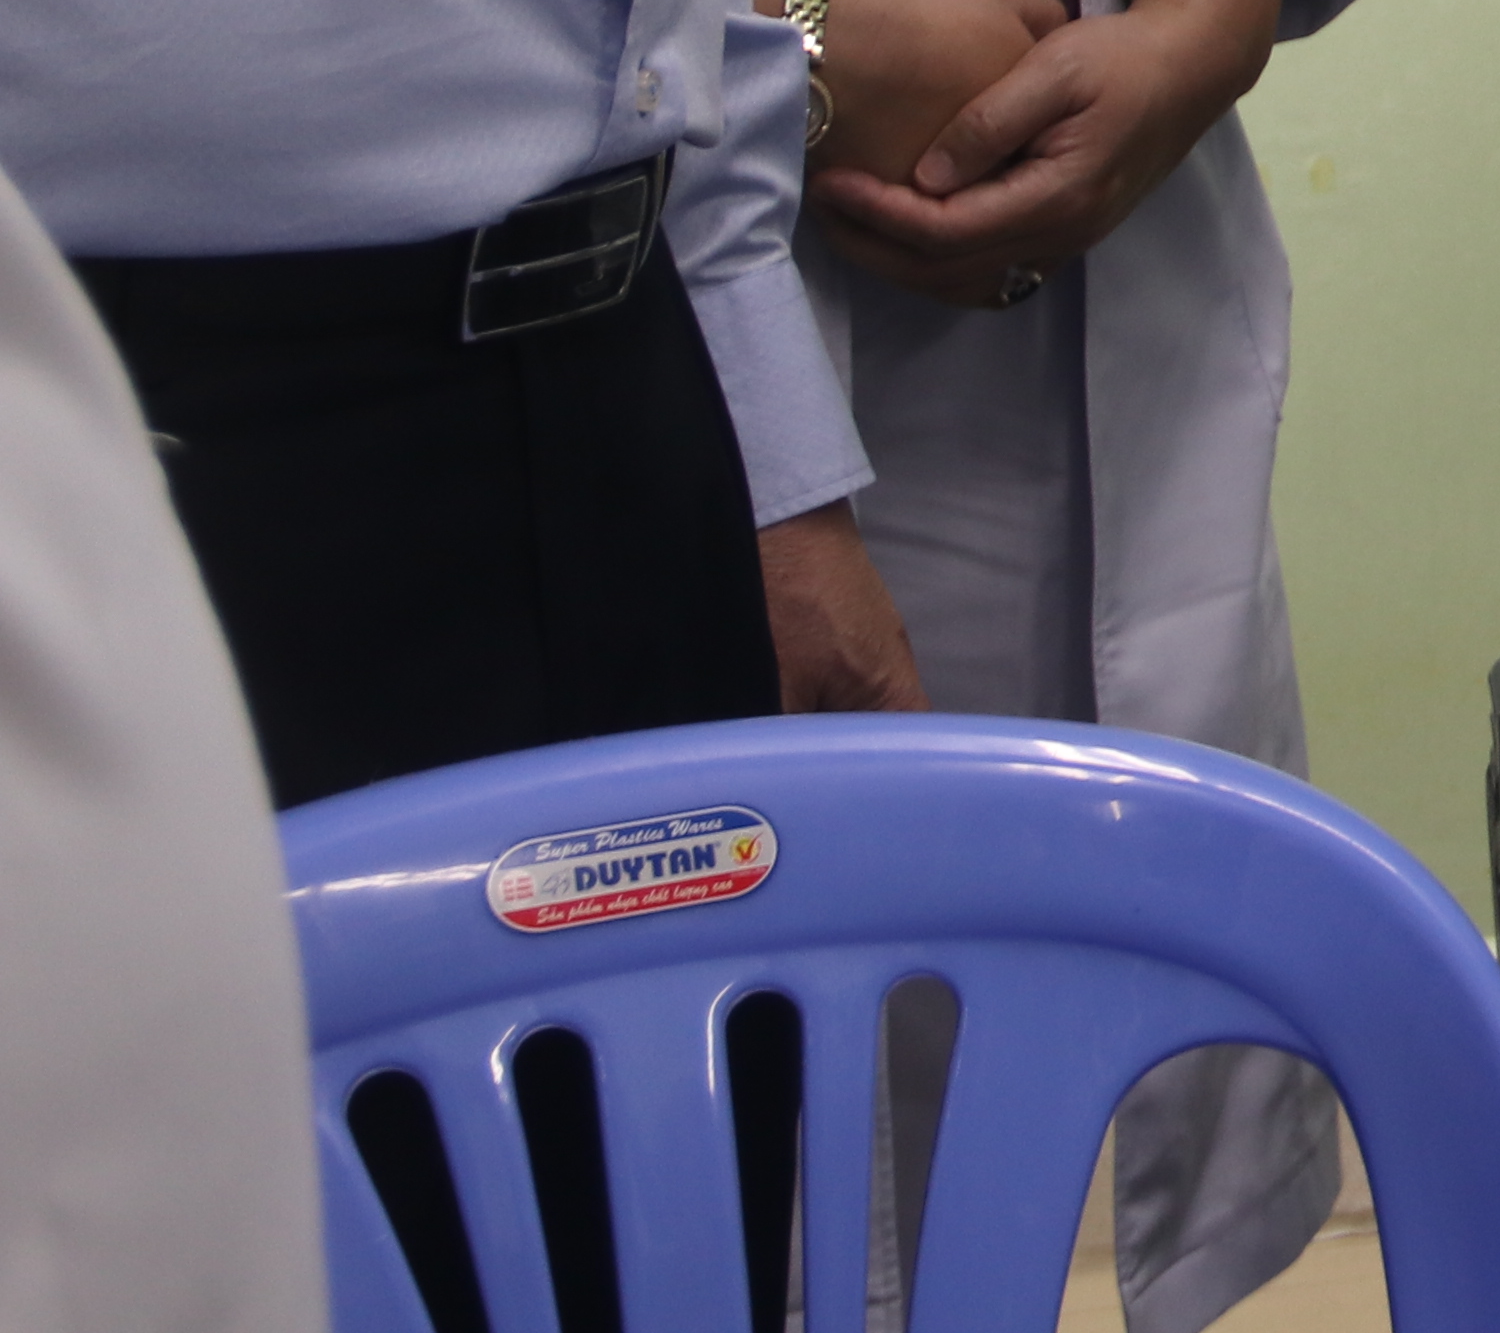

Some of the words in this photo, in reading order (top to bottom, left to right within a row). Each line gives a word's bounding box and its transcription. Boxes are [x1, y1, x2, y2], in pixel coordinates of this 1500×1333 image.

[535, 840, 589, 862] Super
[594, 824, 664, 852] Plastics
[668, 815, 725, 837] Wares
[574, 846, 718, 893] DUYTAN
